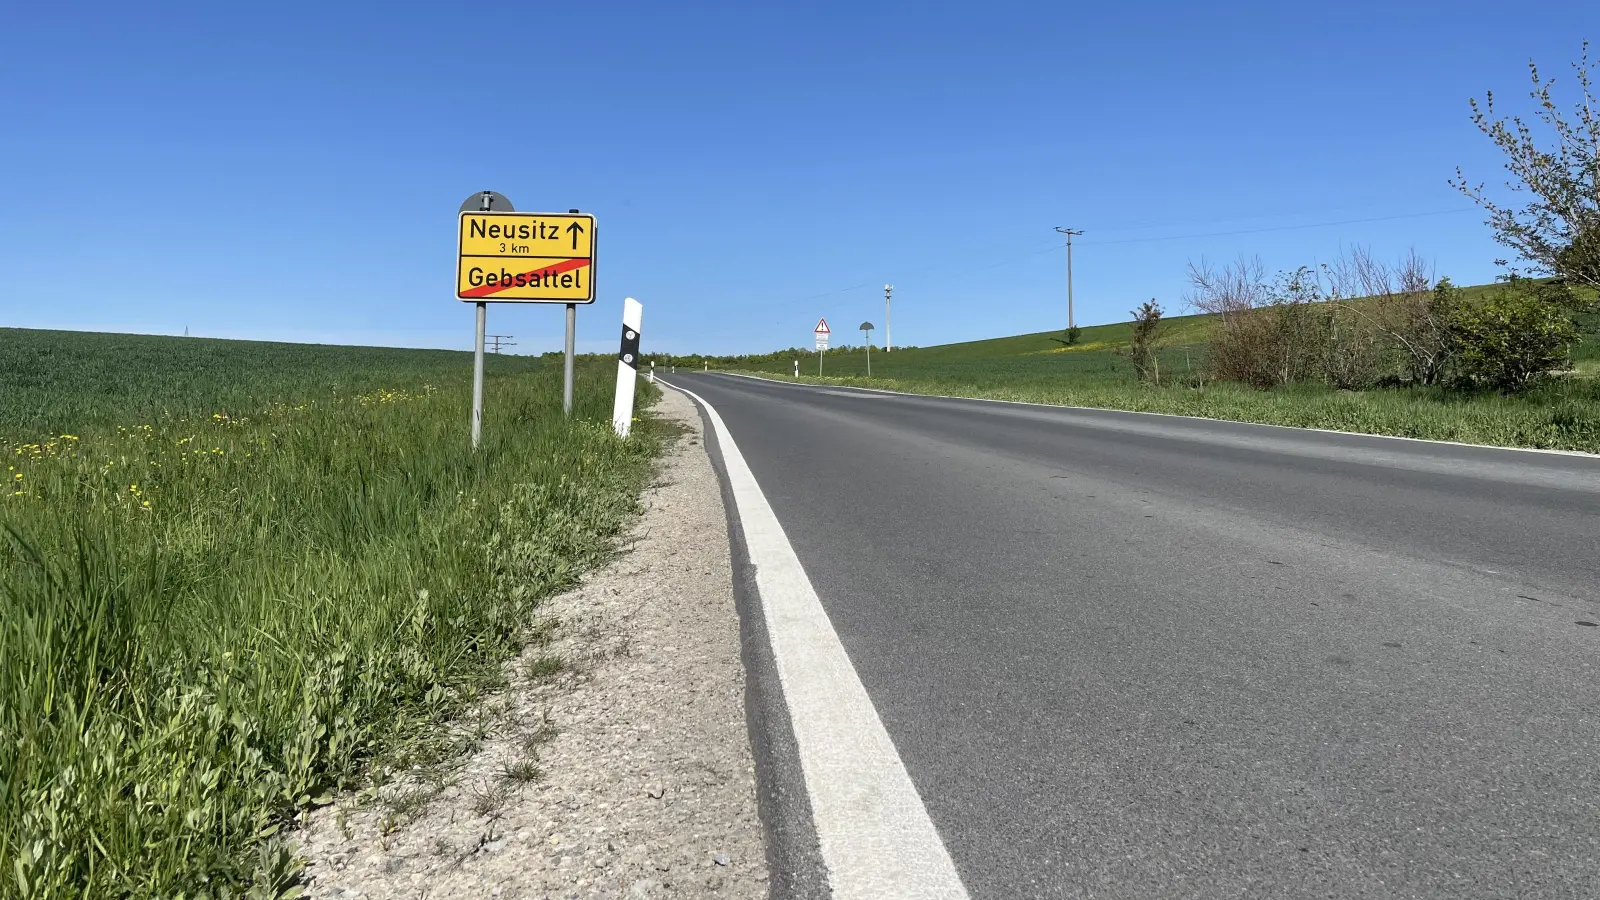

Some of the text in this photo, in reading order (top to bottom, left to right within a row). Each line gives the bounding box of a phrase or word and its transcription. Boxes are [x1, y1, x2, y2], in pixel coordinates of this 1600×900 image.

[470, 219, 559, 239] Neusitz
[499, 243, 529, 253] 3 km
[468, 267, 581, 288] Gebsattel
